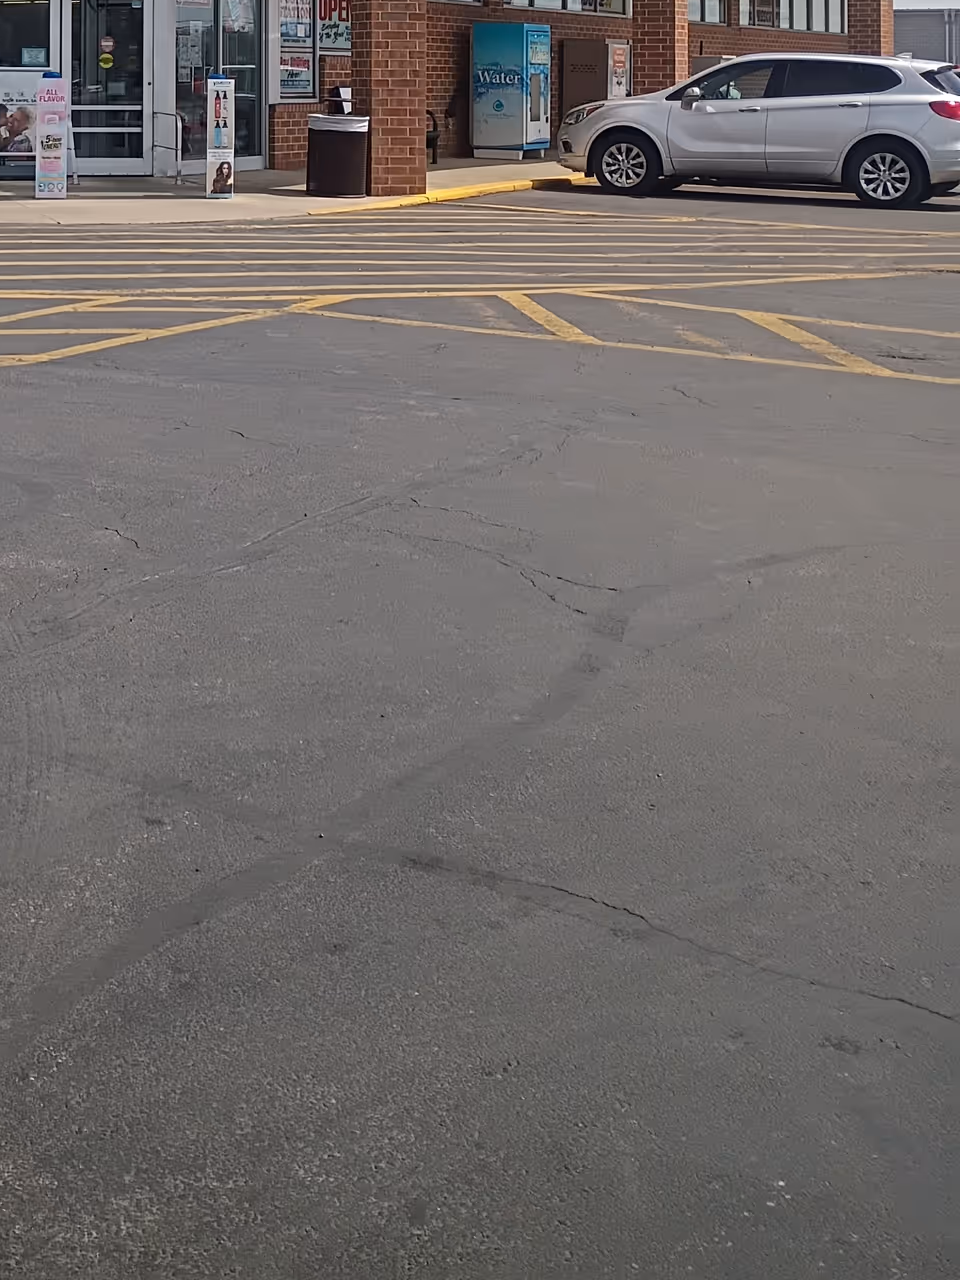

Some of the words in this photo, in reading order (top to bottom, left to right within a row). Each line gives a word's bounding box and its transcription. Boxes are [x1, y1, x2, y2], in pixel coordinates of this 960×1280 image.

[476, 70, 521, 84] Water
[45, 88, 58, 96] ALL
[38, 95, 65, 103] FLAVOR
